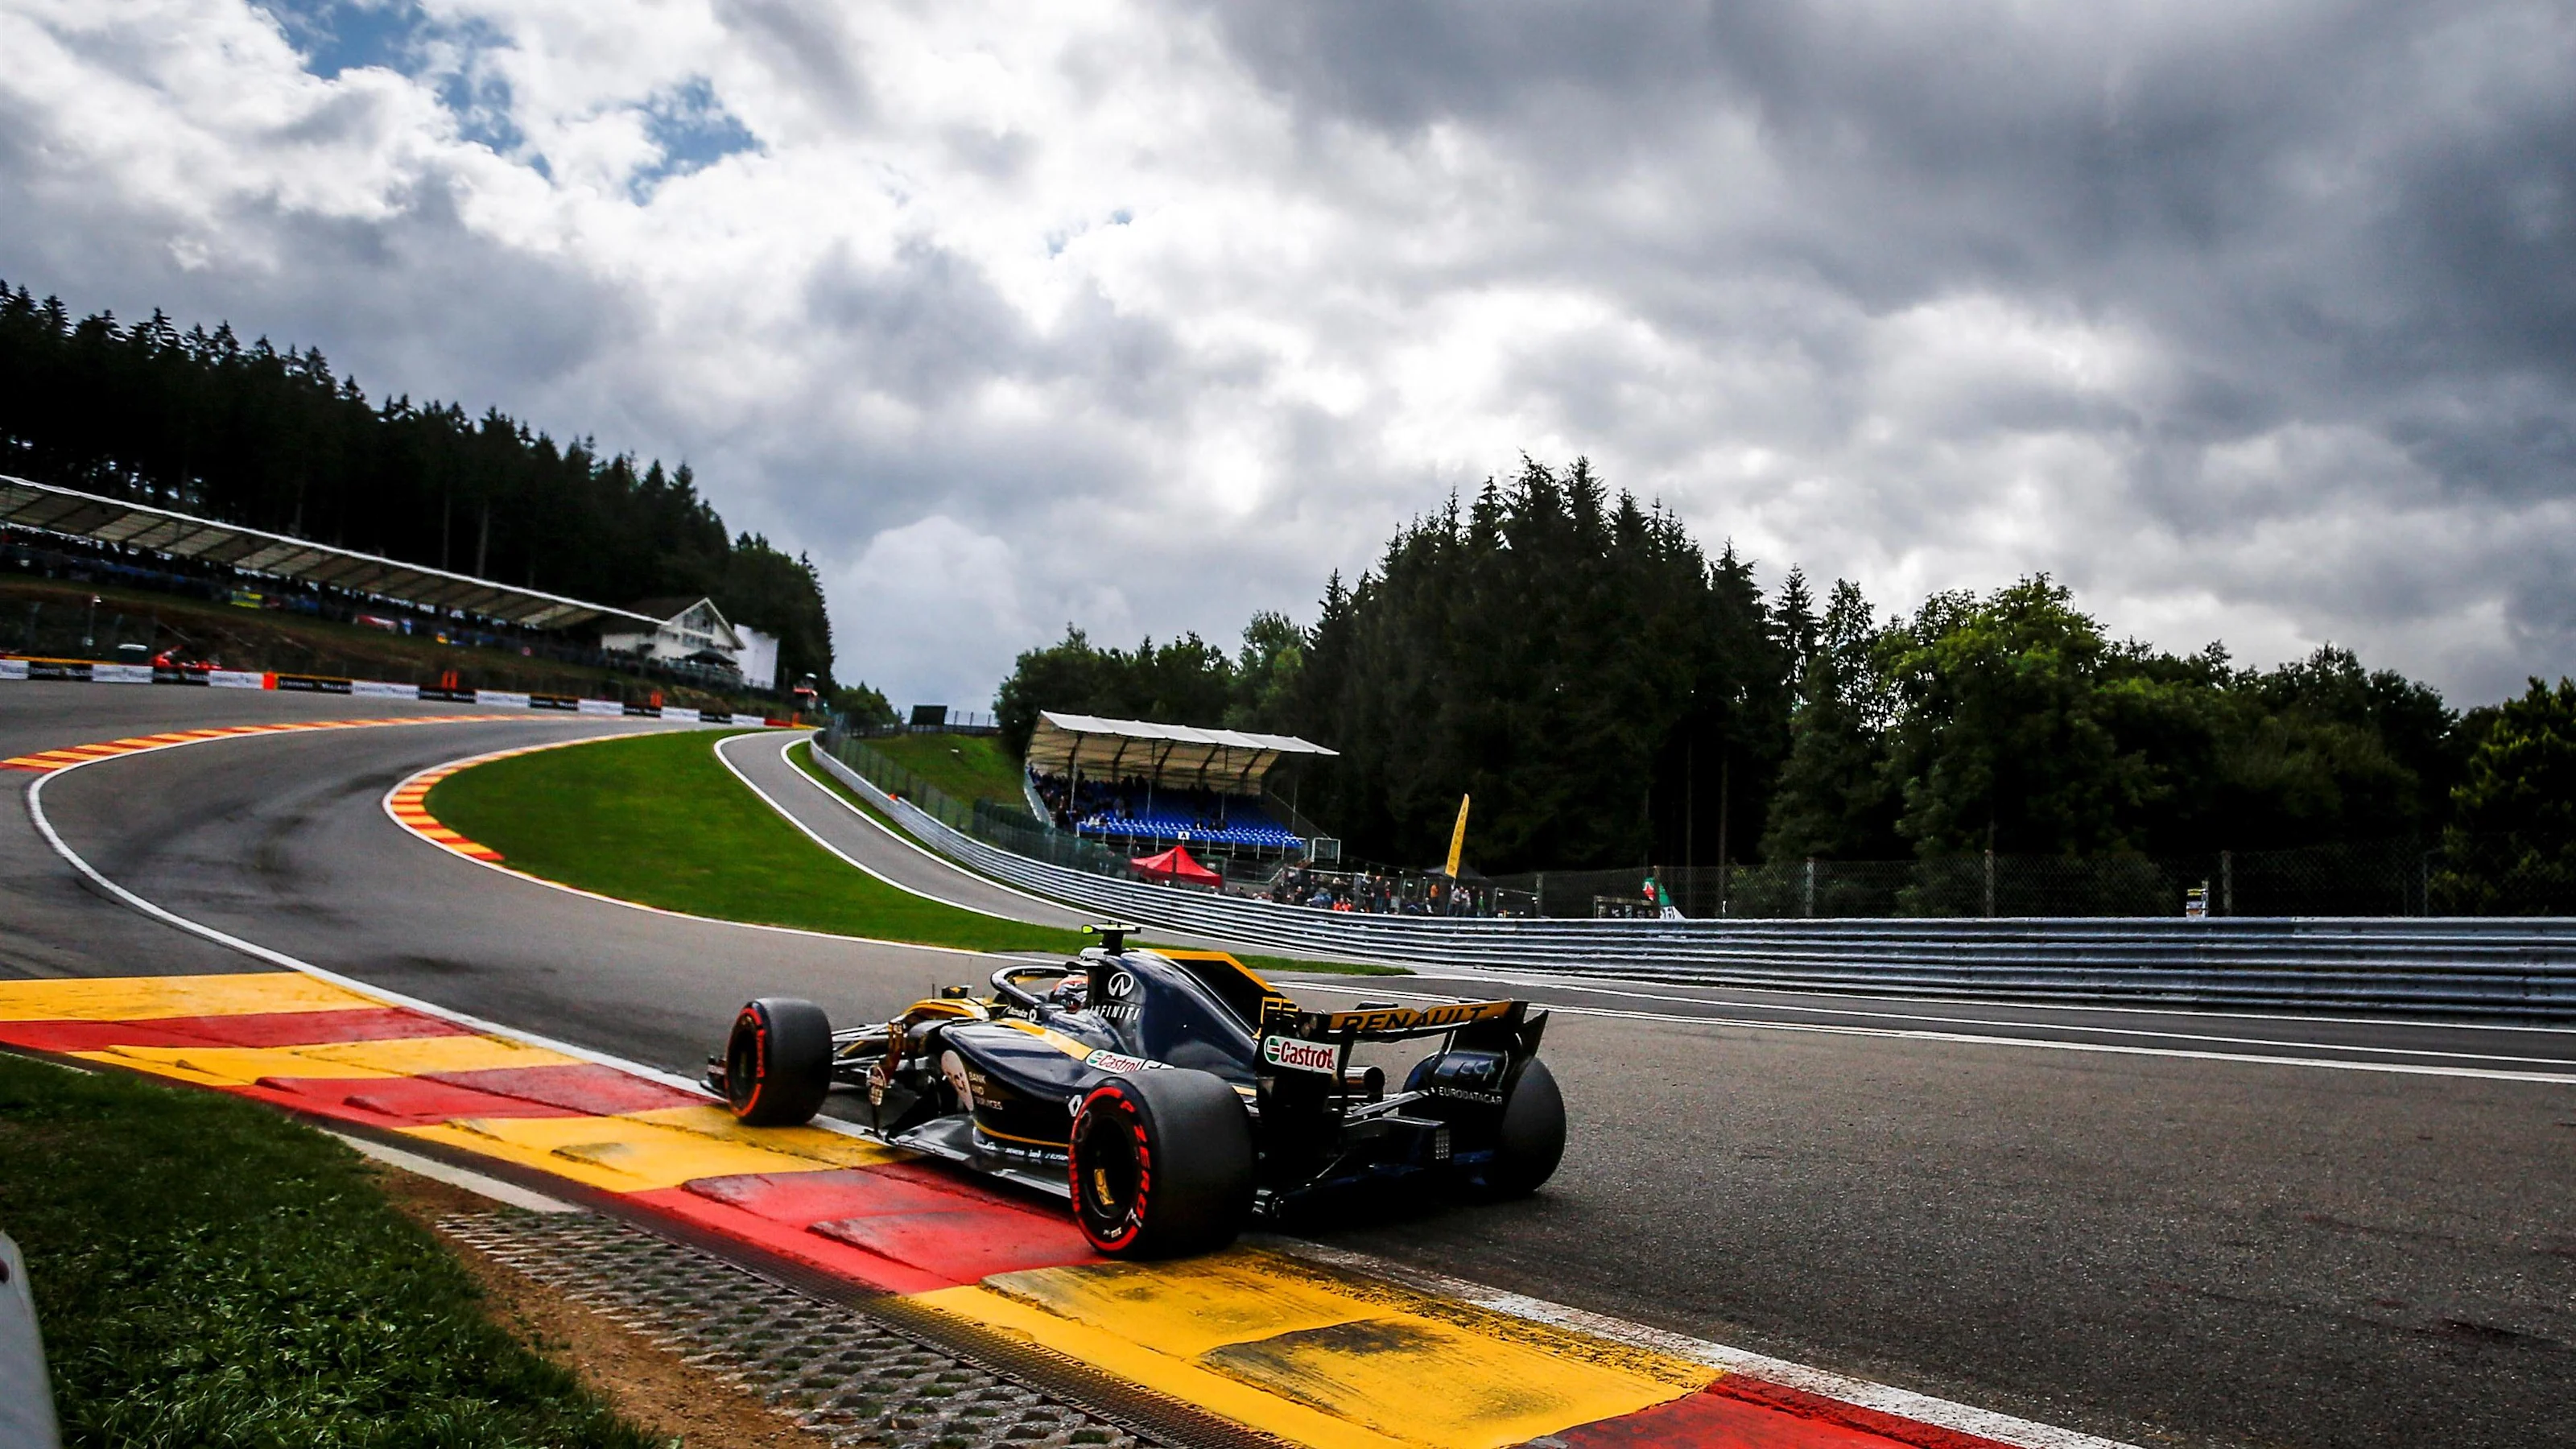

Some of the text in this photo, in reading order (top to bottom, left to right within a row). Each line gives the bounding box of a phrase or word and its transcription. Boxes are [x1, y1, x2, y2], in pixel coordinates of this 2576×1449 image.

[1089, 1005, 1141, 1021] INFINITI
[1338, 1005, 1488, 1031] RENAULT
[1099, 1055, 1141, 1072] Castrol
[1280, 1041, 1335, 1071] Castrol
[968, 1071, 986, 1084] BANK
[1439, 1086, 1503, 1105] EURODATACAR
[1133, 1125, 1151, 1220] ZERO
